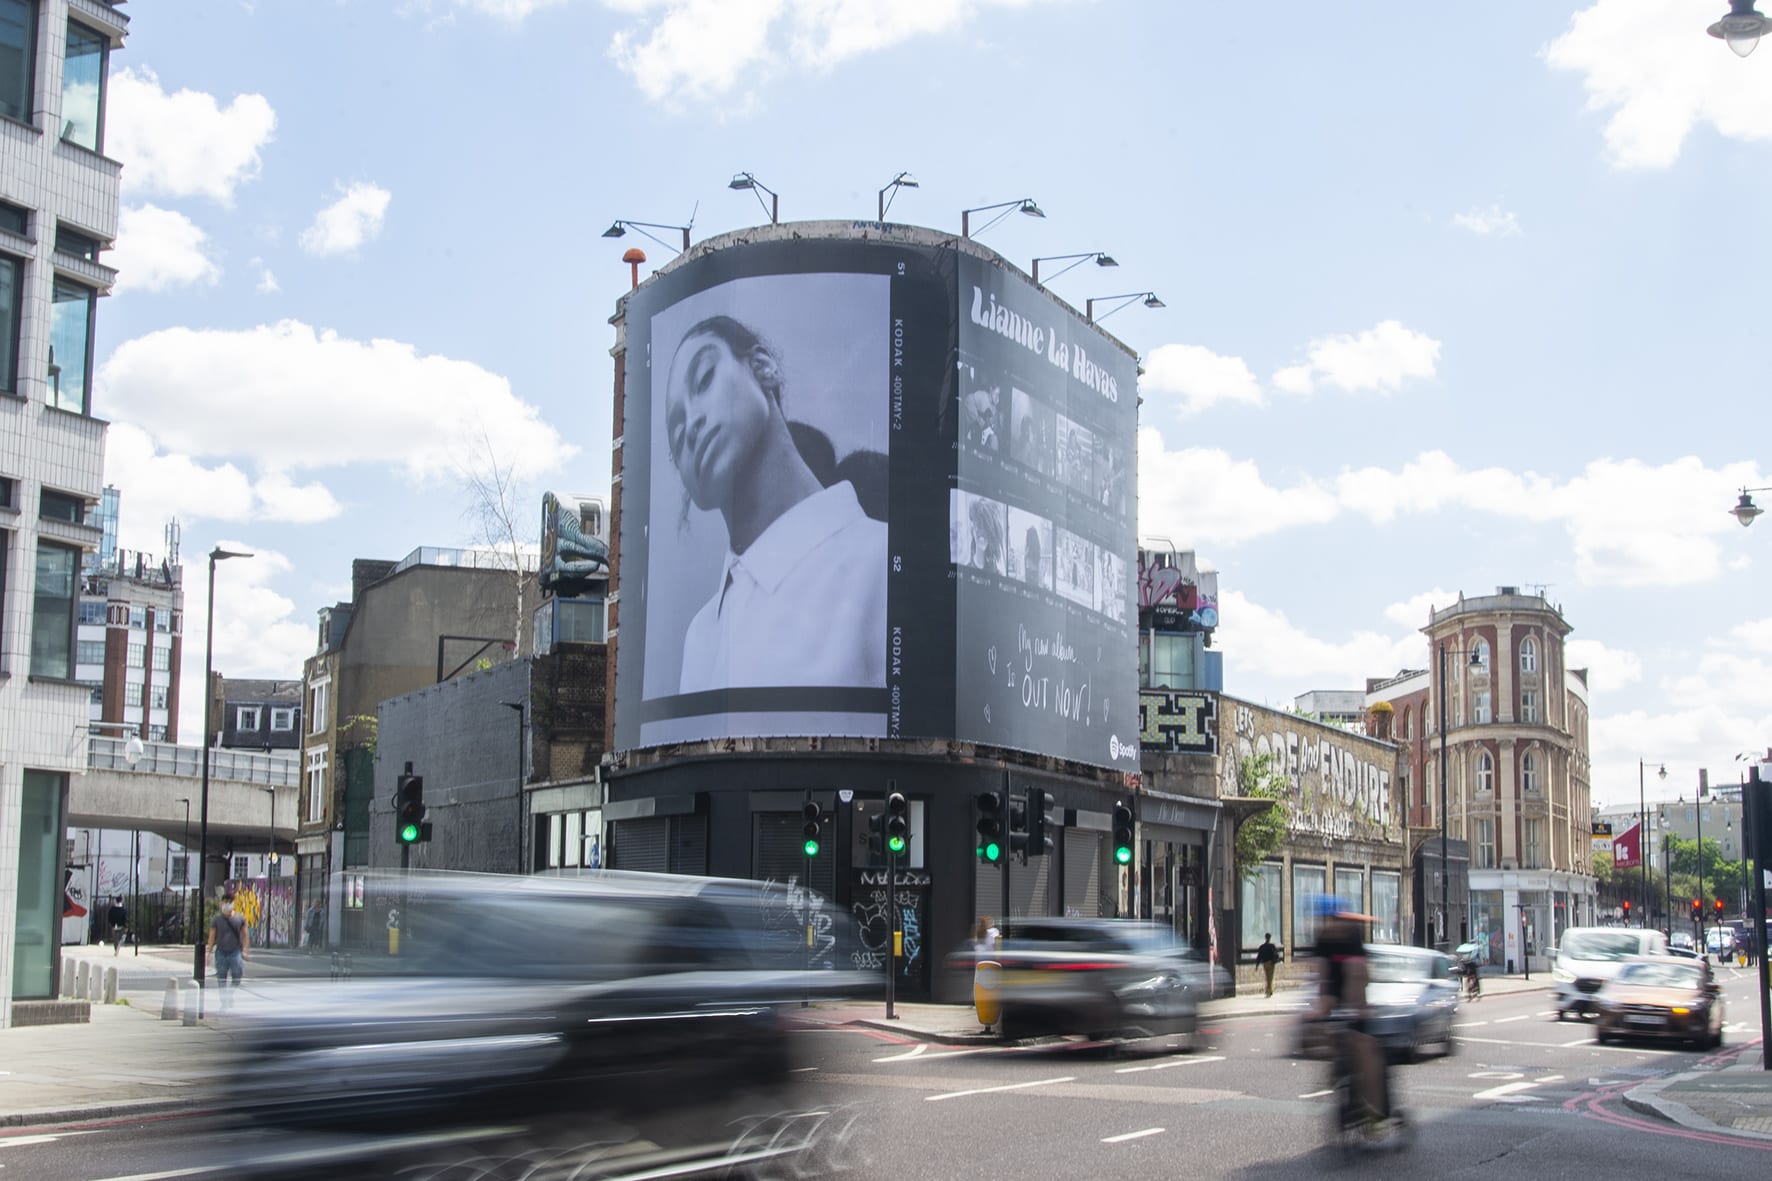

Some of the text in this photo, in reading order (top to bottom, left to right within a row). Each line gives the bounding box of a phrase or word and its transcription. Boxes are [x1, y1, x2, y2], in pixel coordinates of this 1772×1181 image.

[970, 285, 1119, 404] Lianne La Havas
[893, 319, 904, 431] KODAK 400TMY-2
[892, 627, 902, 676] KODAK
[1018, 623, 1033, 673] My
[1021, 673, 1049, 710] OUT
[1119, 743, 1137, 760] Spotify
